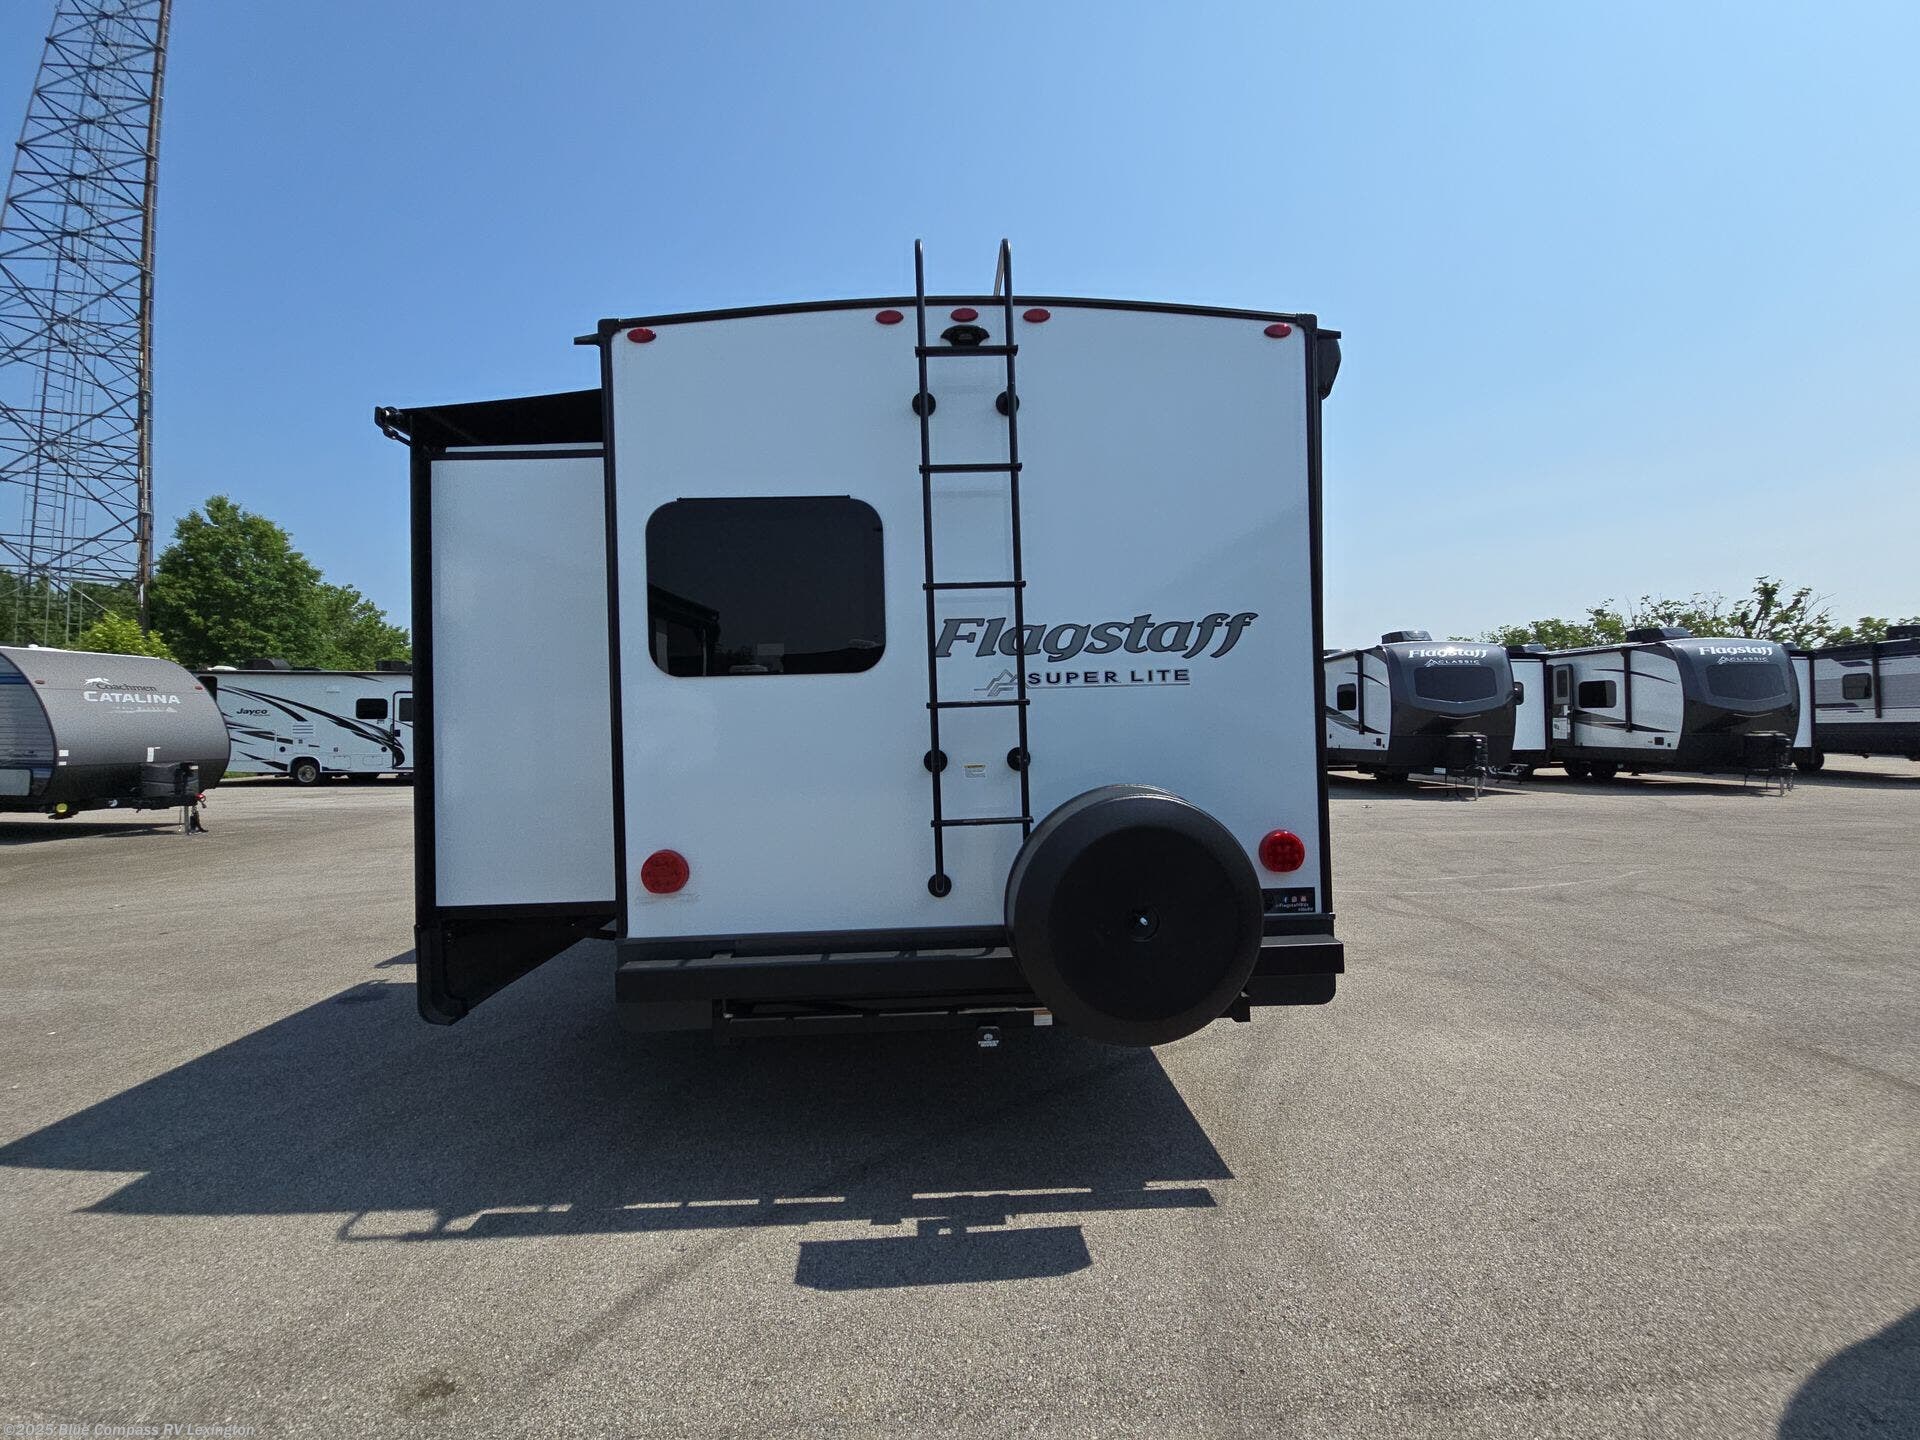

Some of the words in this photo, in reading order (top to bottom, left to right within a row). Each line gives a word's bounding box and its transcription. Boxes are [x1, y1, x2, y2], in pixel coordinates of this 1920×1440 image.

[935, 612, 1258, 662] Flagstaff
[1408, 648, 1489, 658] Flagstaff
[1698, 646, 1773, 655] Flagstaff
[1028, 671, 1120, 685] SUPER
[1130, 669, 1190, 682] LITE
[94, 682, 157, 692] Coachmen
[83, 691, 181, 704] CATALINA
[236, 708, 268, 716] Jayco
